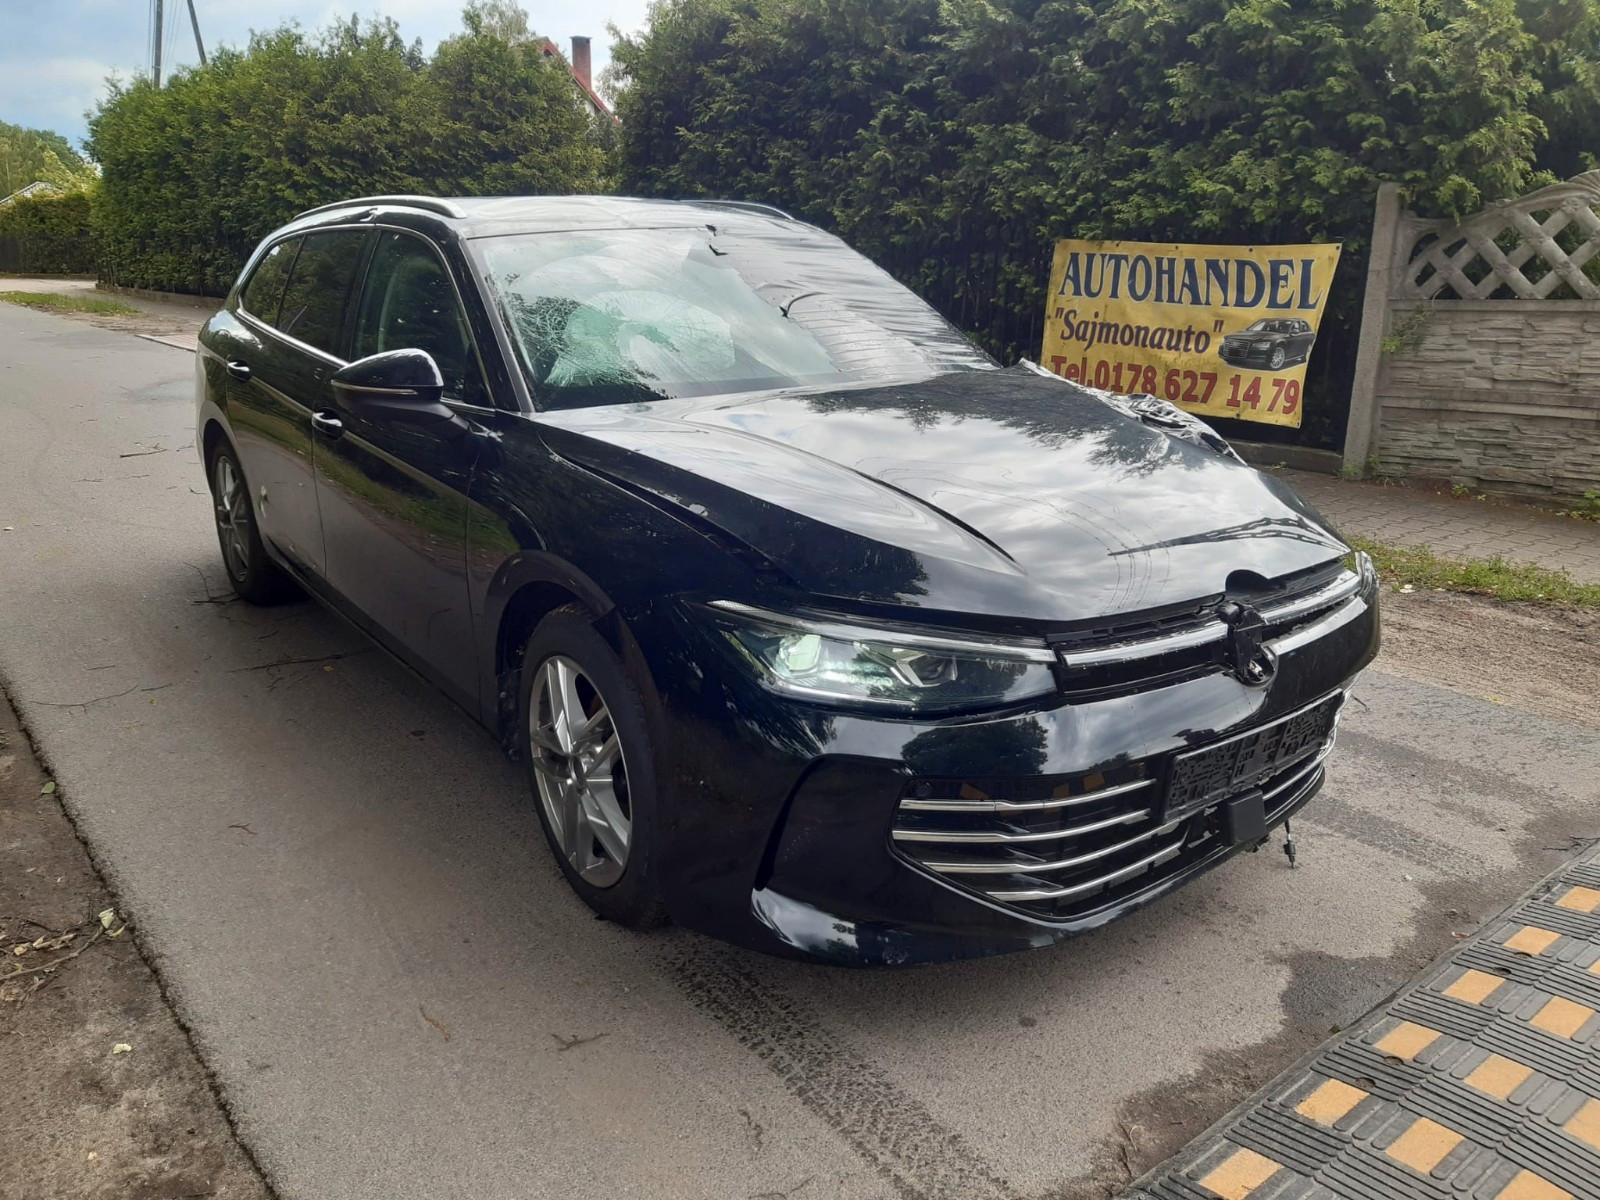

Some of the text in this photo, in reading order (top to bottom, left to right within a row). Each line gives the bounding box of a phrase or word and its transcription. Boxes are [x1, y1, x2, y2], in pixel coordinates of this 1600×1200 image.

[1059, 252, 1322, 309] AUTOHANDEL
[1164, 368, 1218, 404] 627
[1226, 374, 1261, 410] 14
[1266, 378, 1301, 415] 79
